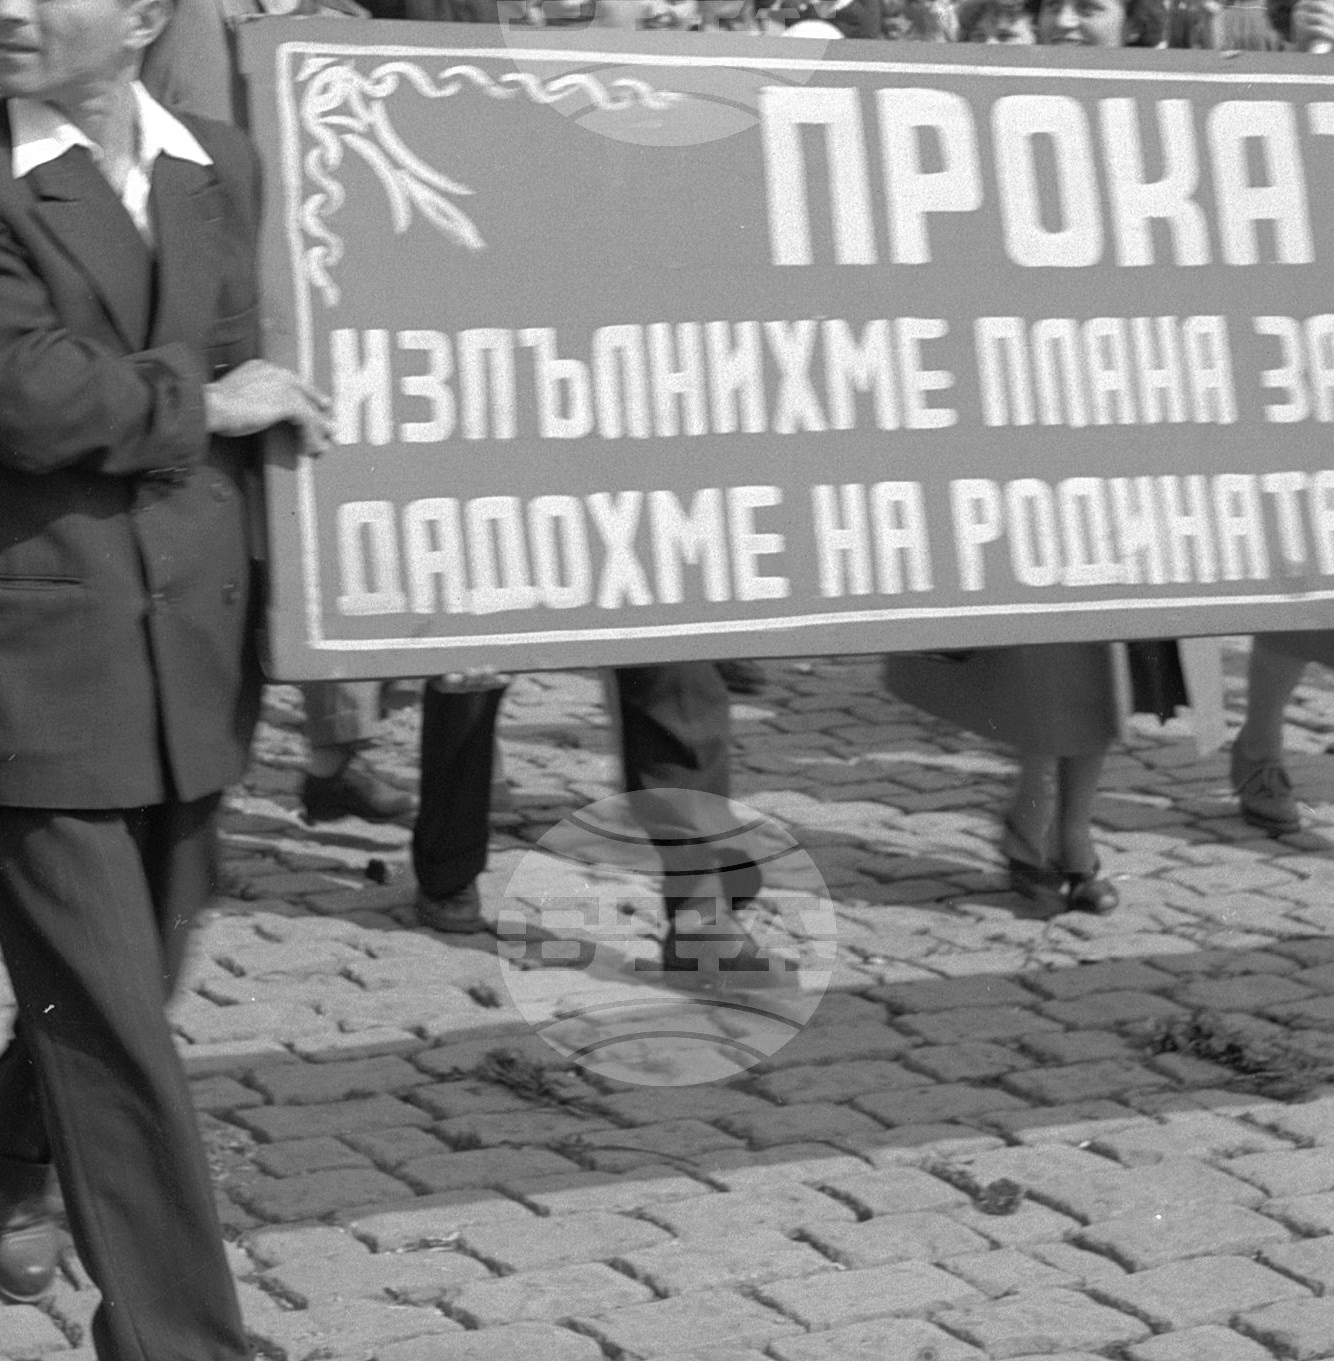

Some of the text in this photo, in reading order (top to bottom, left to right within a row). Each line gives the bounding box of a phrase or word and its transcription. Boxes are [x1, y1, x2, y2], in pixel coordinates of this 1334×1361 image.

[330, 316, 960, 446] ИЗПЪЛНИХМЕ
[973, 314, 1238, 428] ПЛАНА
[335, 484, 791, 616] ДАДОХМЕ
[810, 481, 935, 598] НА
